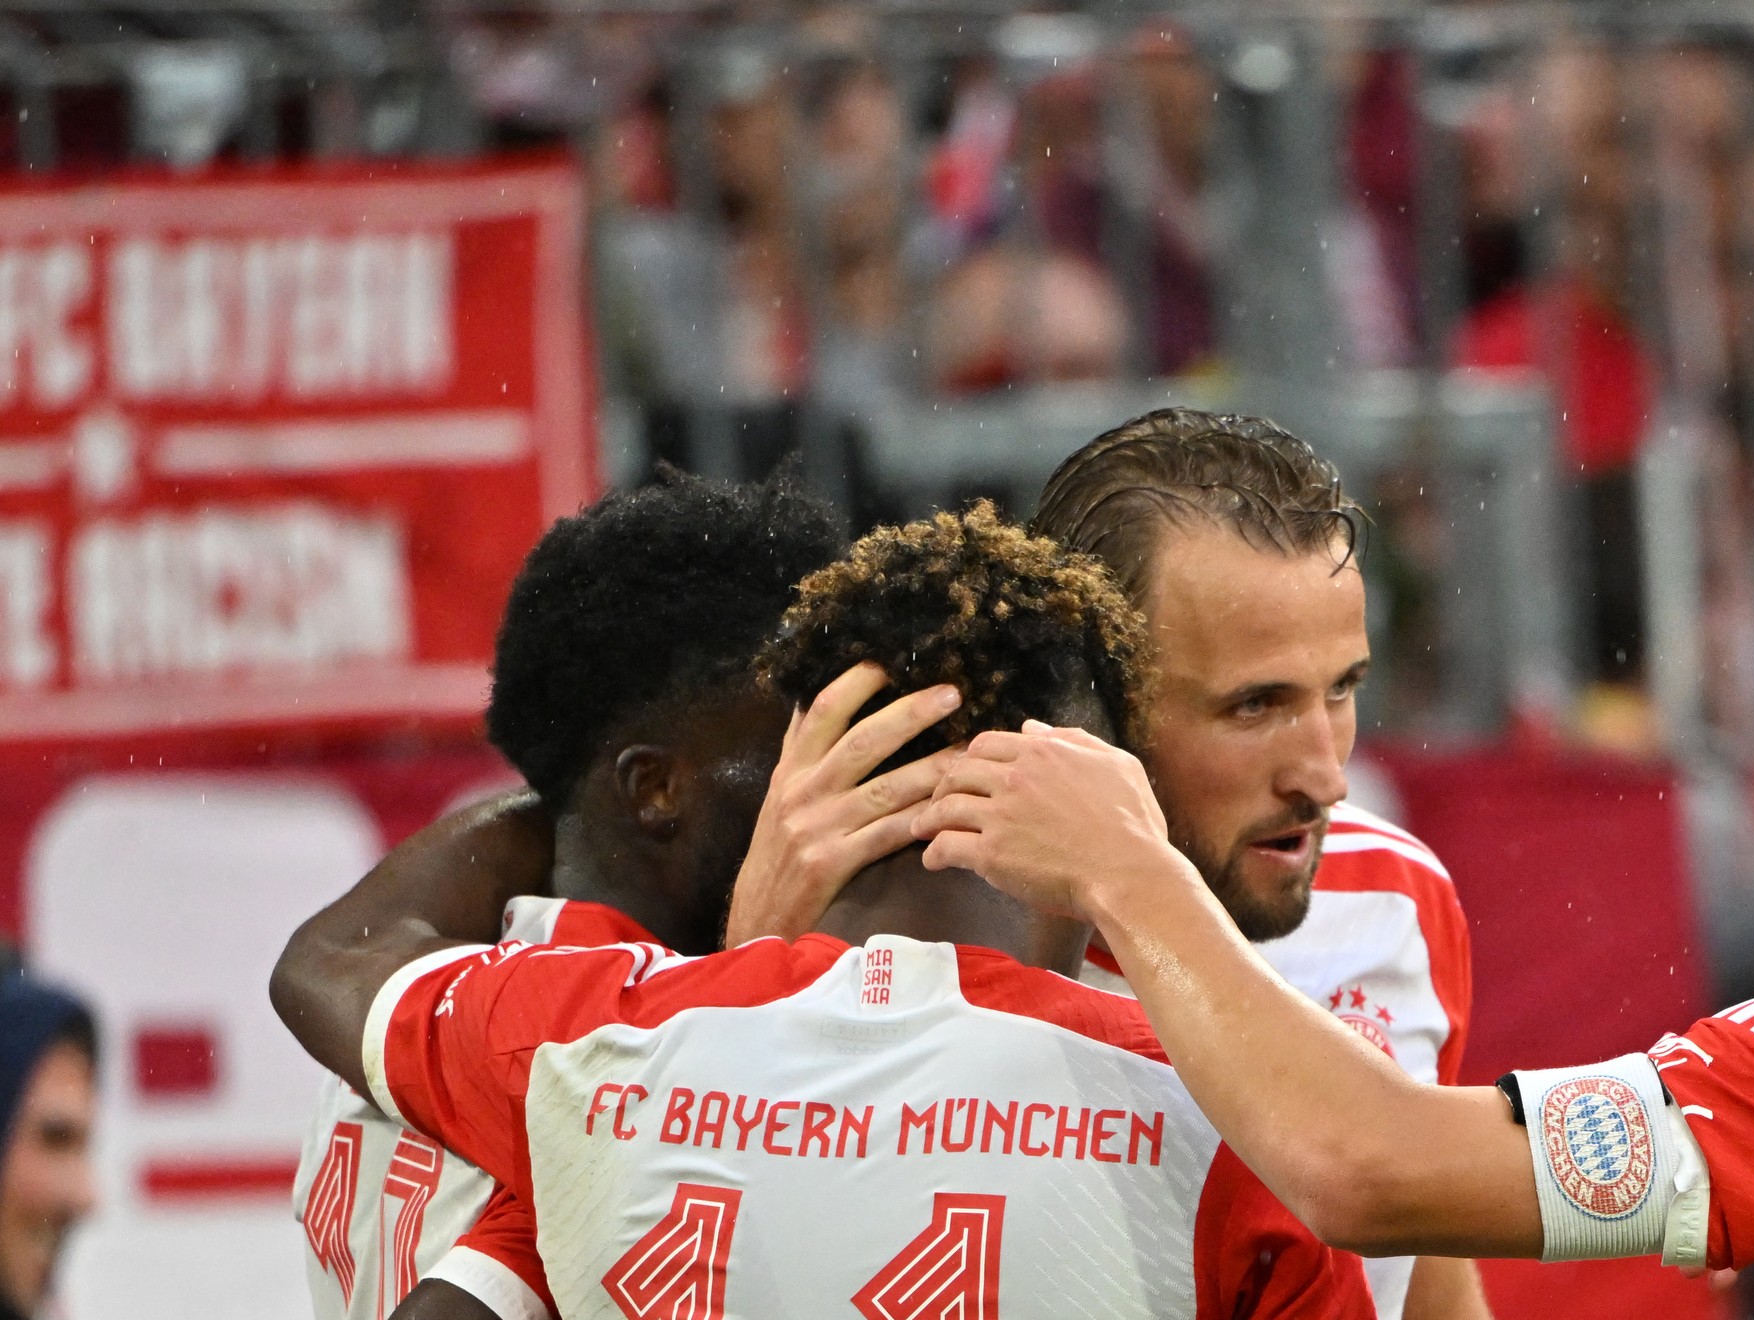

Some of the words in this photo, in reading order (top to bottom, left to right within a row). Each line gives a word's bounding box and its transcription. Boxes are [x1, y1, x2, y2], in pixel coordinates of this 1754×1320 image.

[866, 948, 893, 968] MIA
[864, 968, 892, 986] SAN
[861, 987, 890, 1005] MIA
[585, 1082, 649, 1141] FC
[659, 1087, 875, 1159] BAYERN
[897, 1097, 1165, 1166] MÜNCHEN
